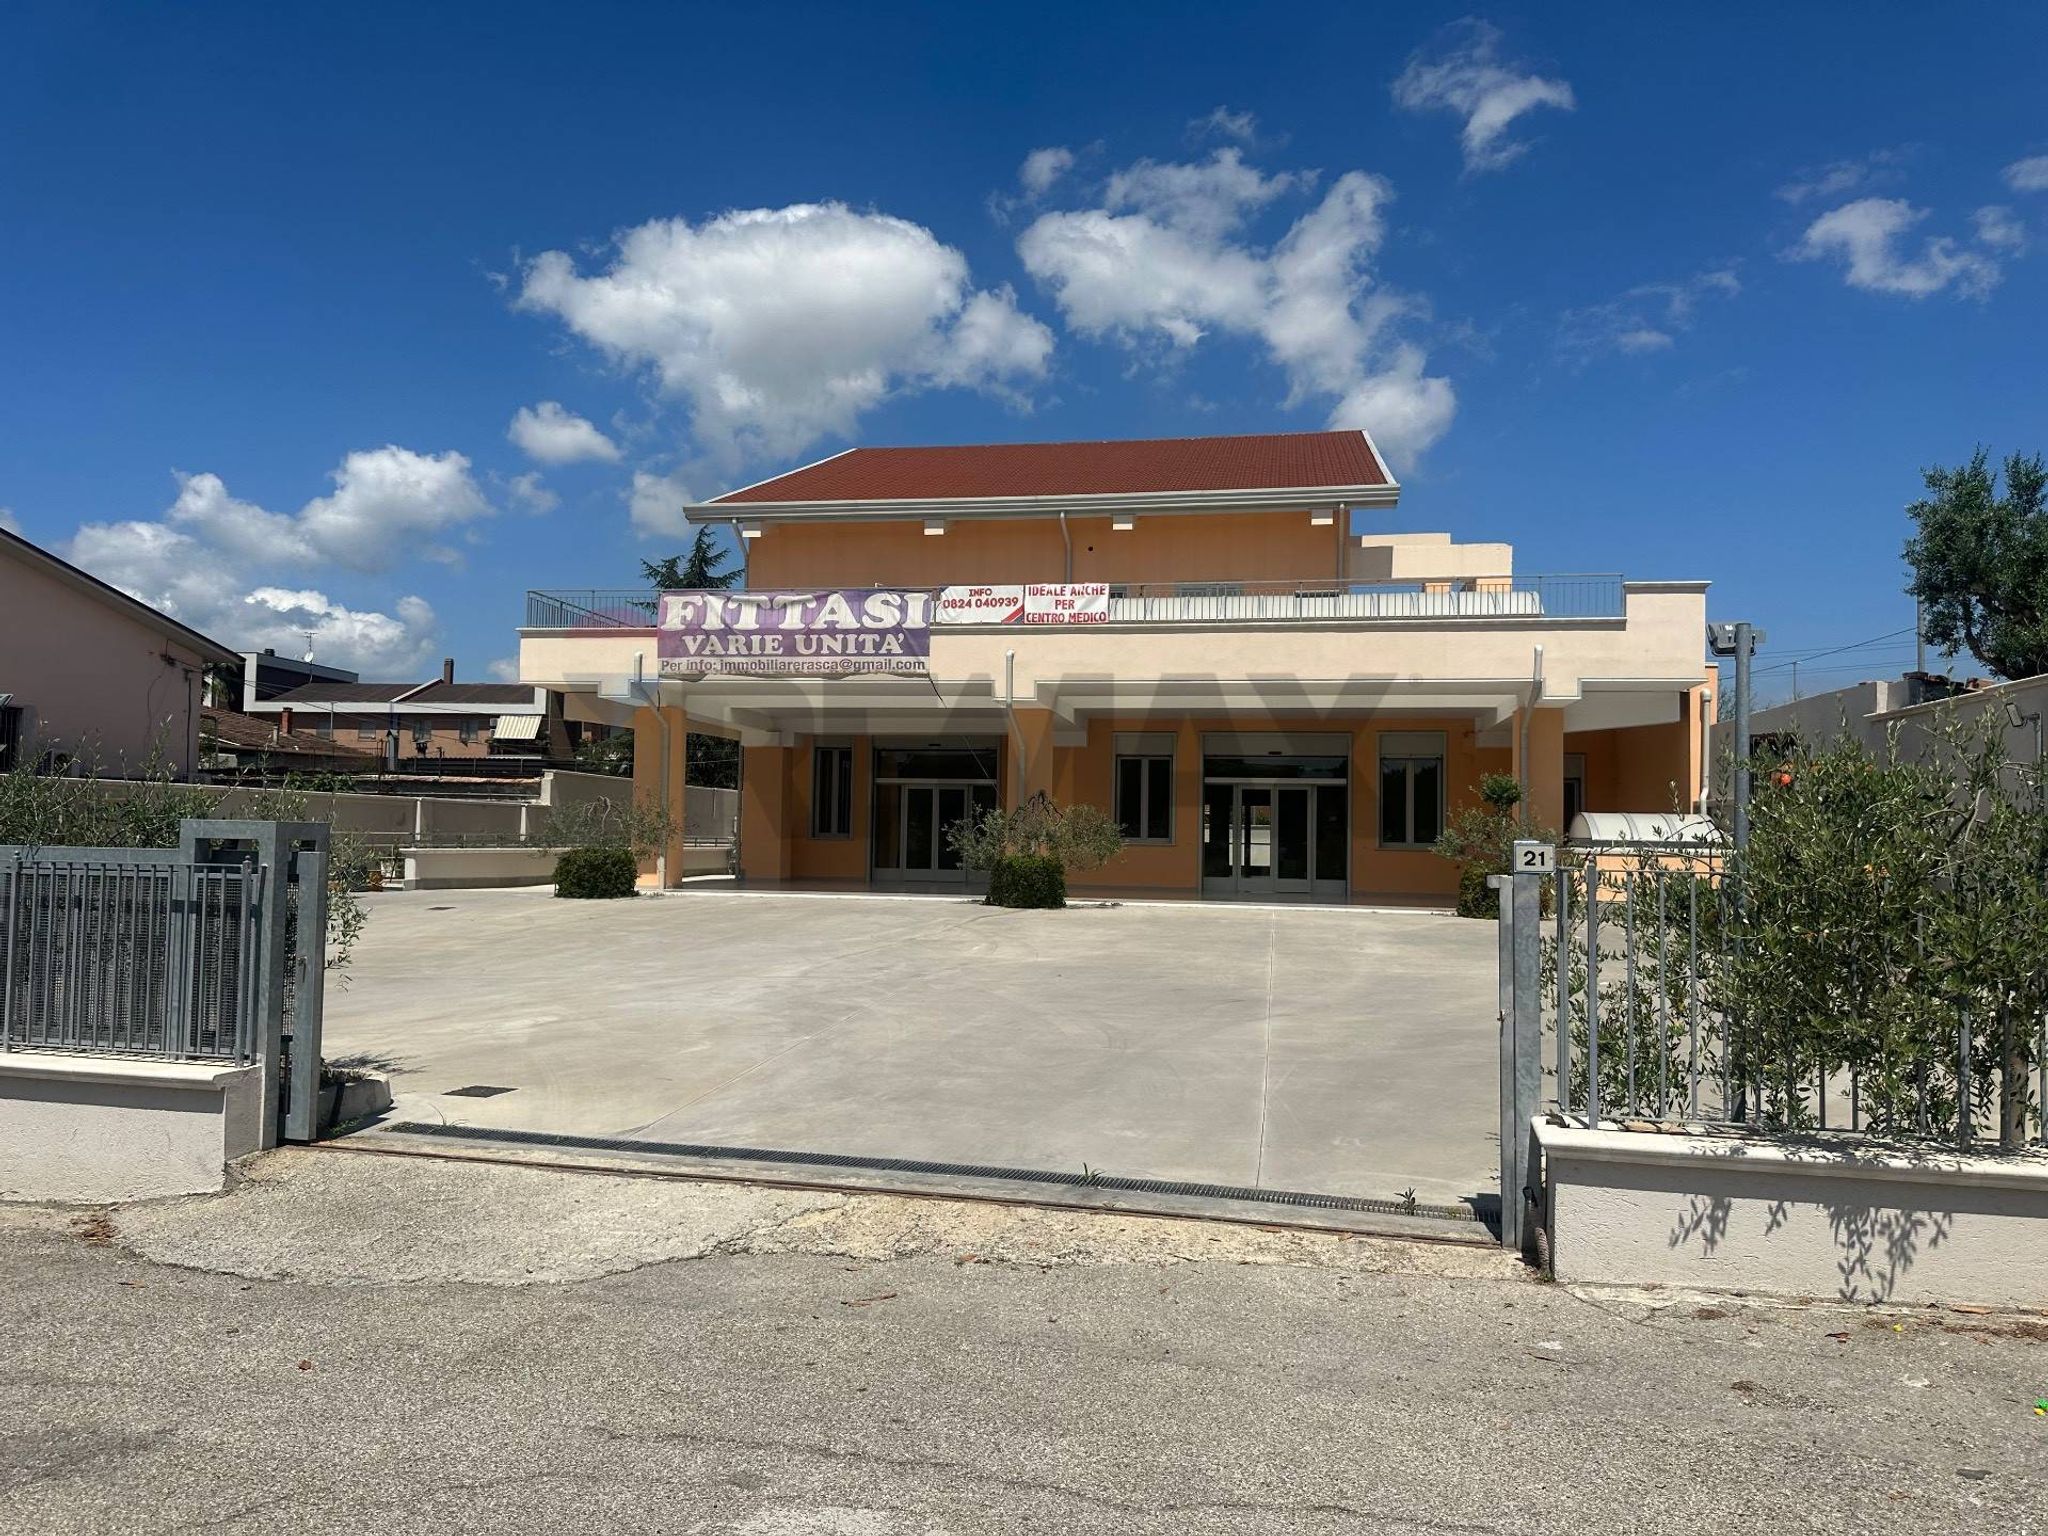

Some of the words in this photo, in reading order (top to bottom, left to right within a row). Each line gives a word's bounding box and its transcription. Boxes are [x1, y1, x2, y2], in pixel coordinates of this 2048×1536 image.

[968, 588, 992, 597] INFO
[1028, 585, 1066, 597] IDEALE
[1070, 585, 1106, 597] ANCHE
[943, 598, 972, 609] 0824
[975, 597, 1019, 608] 040939
[1055, 599, 1075, 610] PER
[661, 592, 929, 630] FITTASI
[1026, 613, 1065, 624] CENTRO
[1068, 612, 1107, 623] MEDICO
[681, 634, 783, 655] VARIE
[661, 659, 682, 671] Per
[686, 659, 717, 671] info:
[1523, 850, 1545, 866] 21
